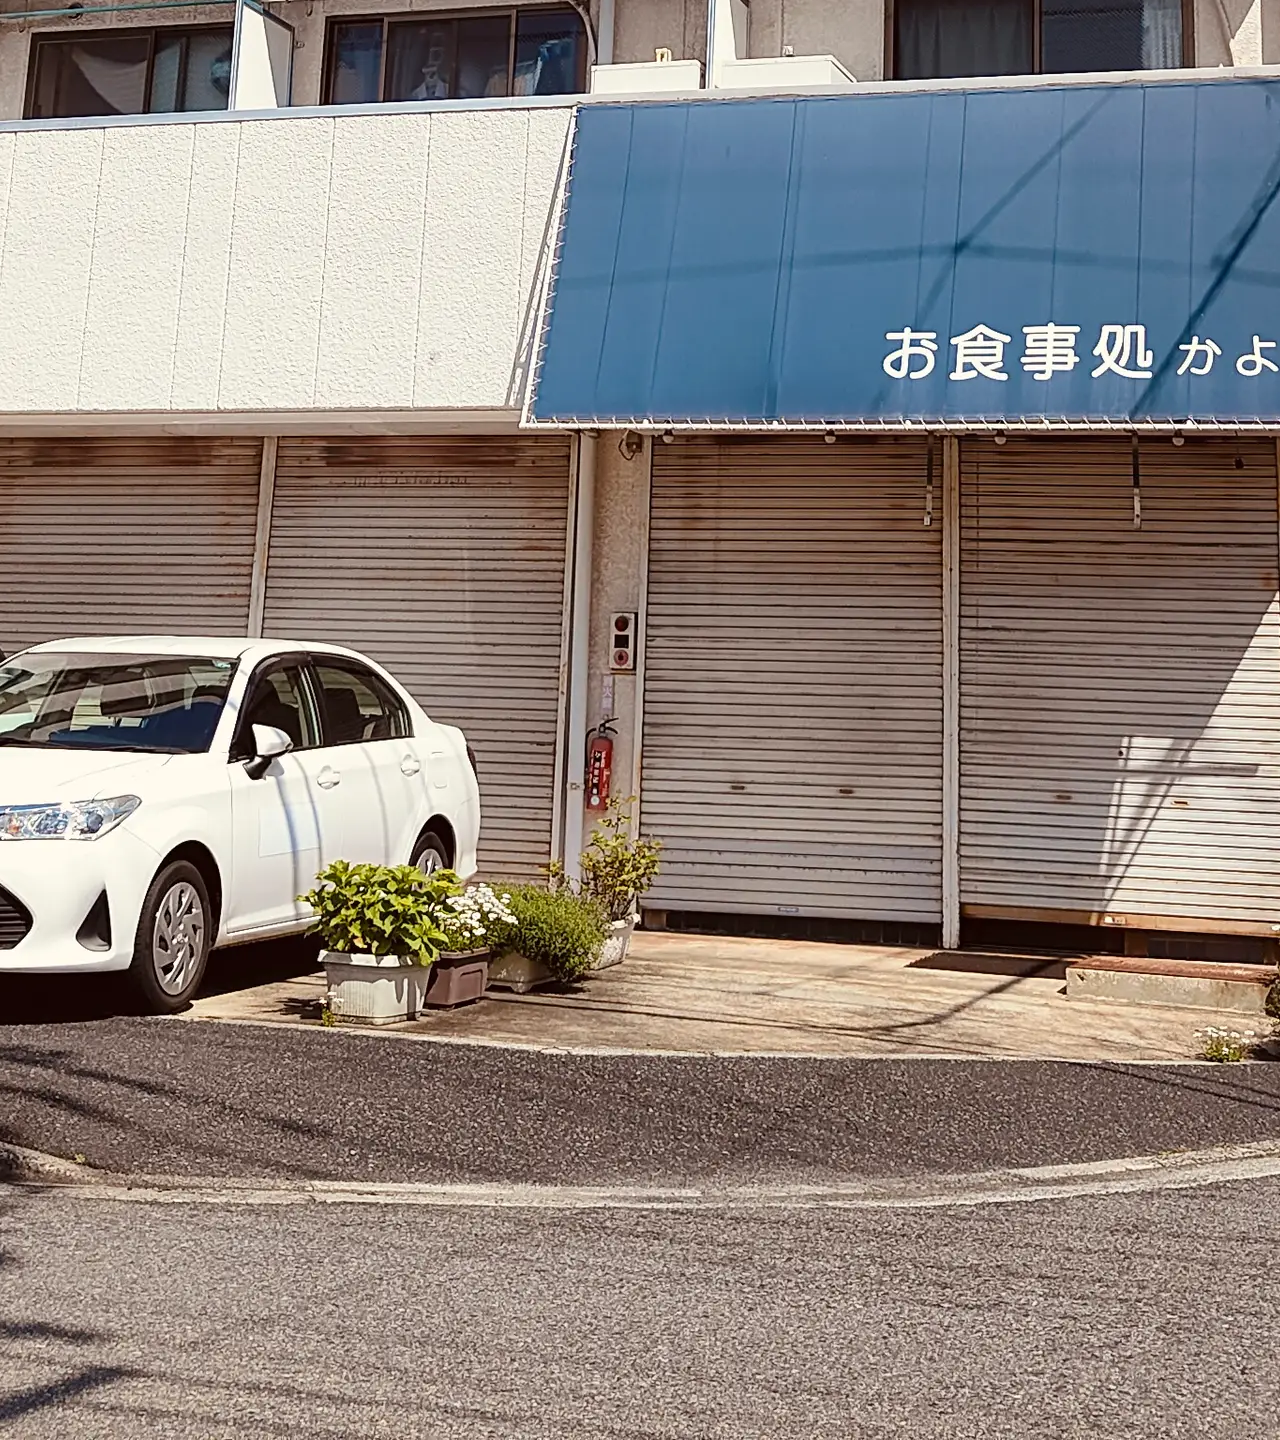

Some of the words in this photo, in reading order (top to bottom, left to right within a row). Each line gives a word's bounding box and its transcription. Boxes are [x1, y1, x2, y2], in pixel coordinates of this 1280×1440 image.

[882, 321, 1153, 382] お食事処
[1176, 334, 1279, 376] かよ
